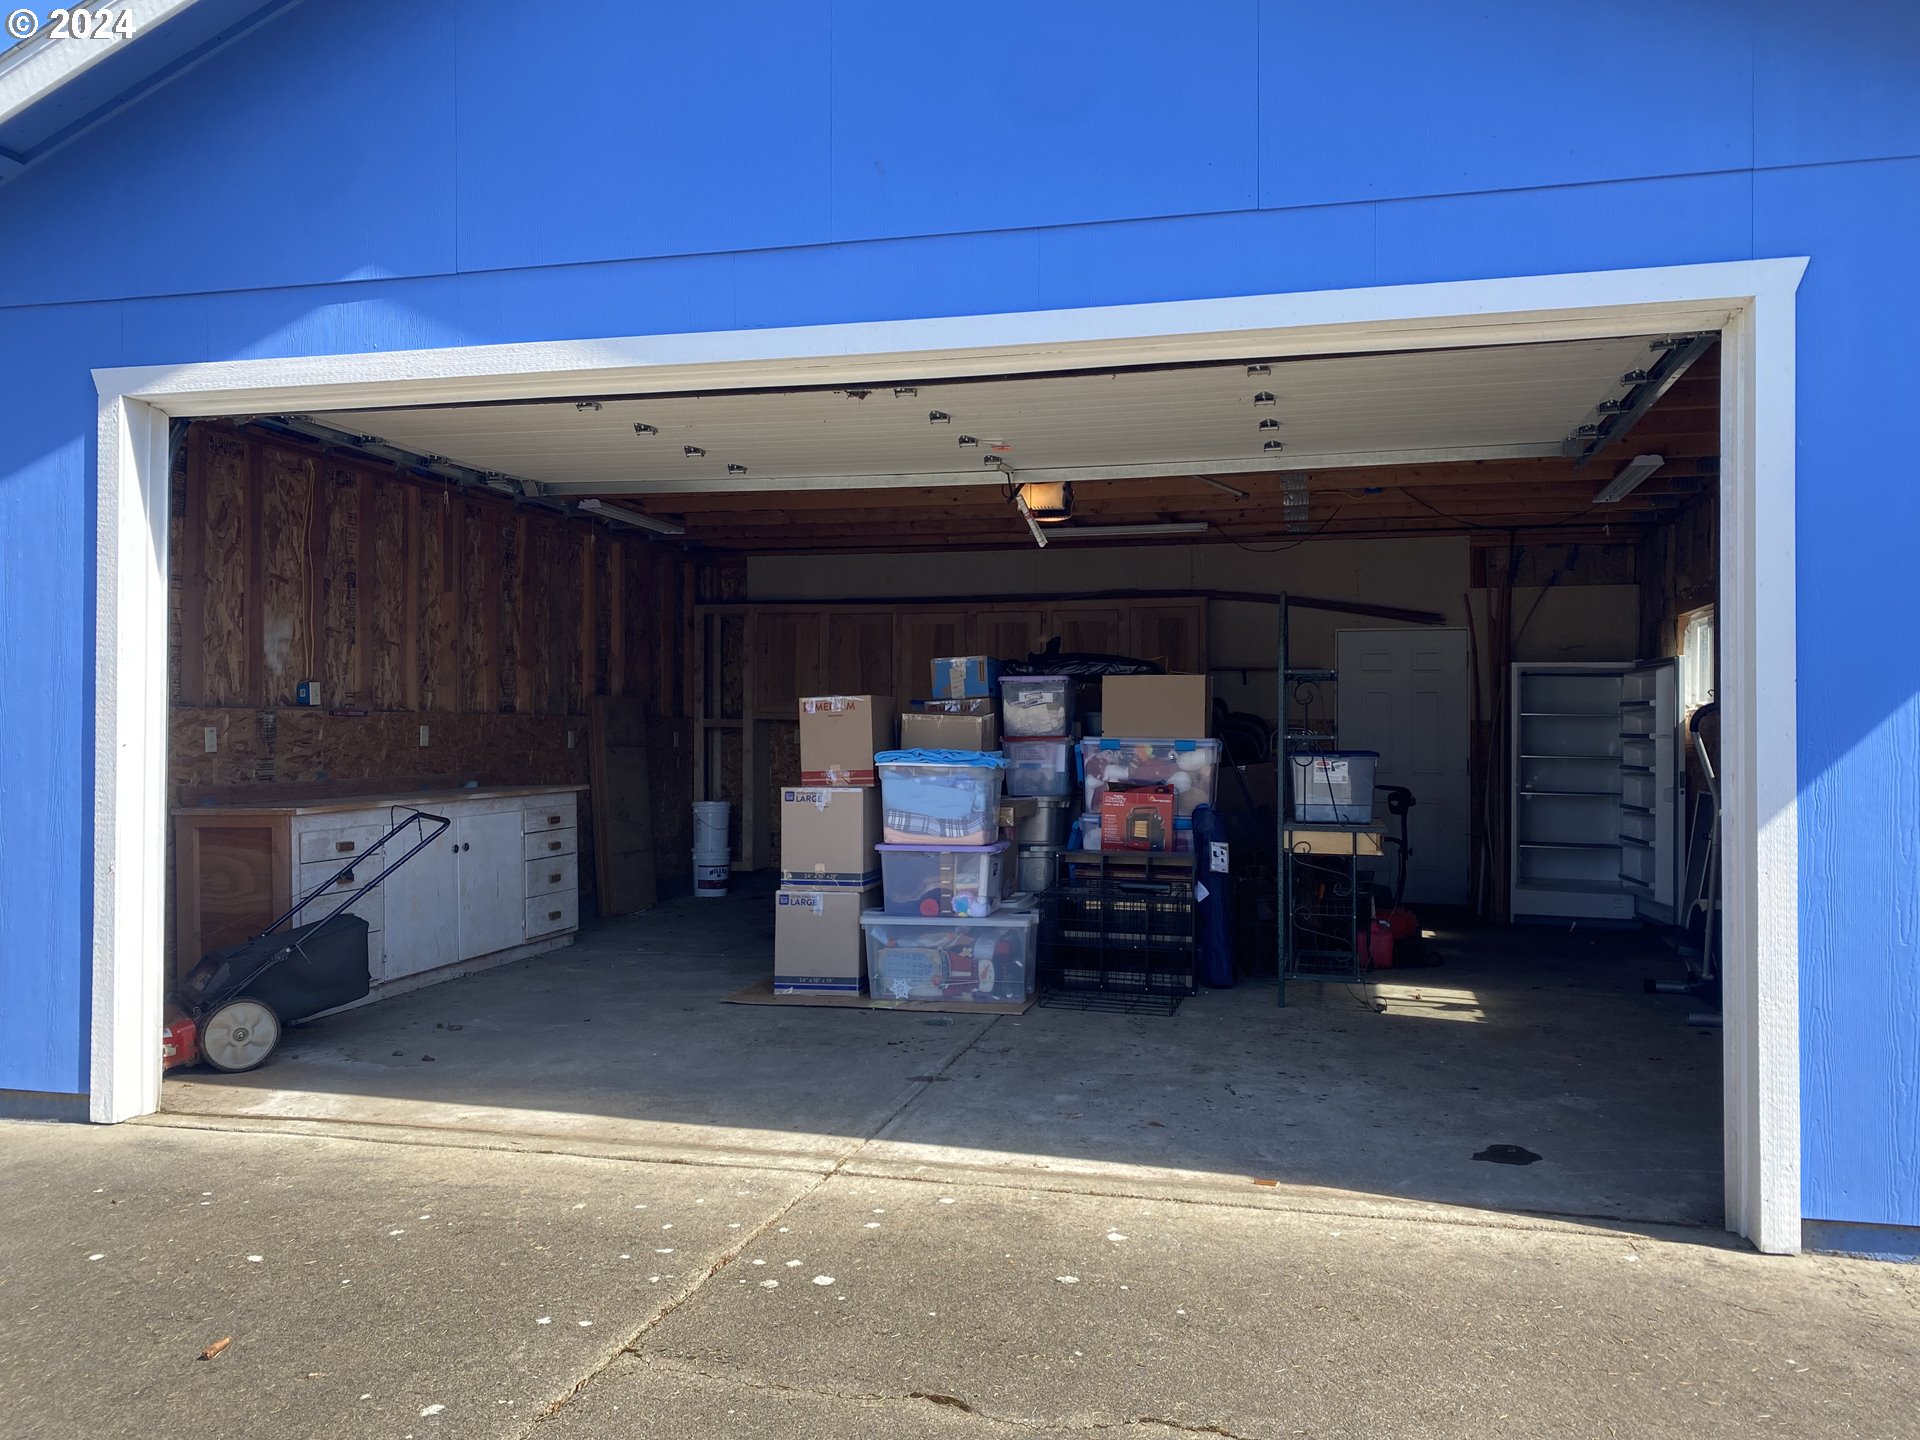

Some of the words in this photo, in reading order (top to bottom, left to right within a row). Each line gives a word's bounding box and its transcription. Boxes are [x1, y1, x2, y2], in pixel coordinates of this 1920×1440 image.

[816, 702, 855, 711] MEM
[796, 795, 823, 803] LARGE
[790, 898, 817, 906] LARGE
